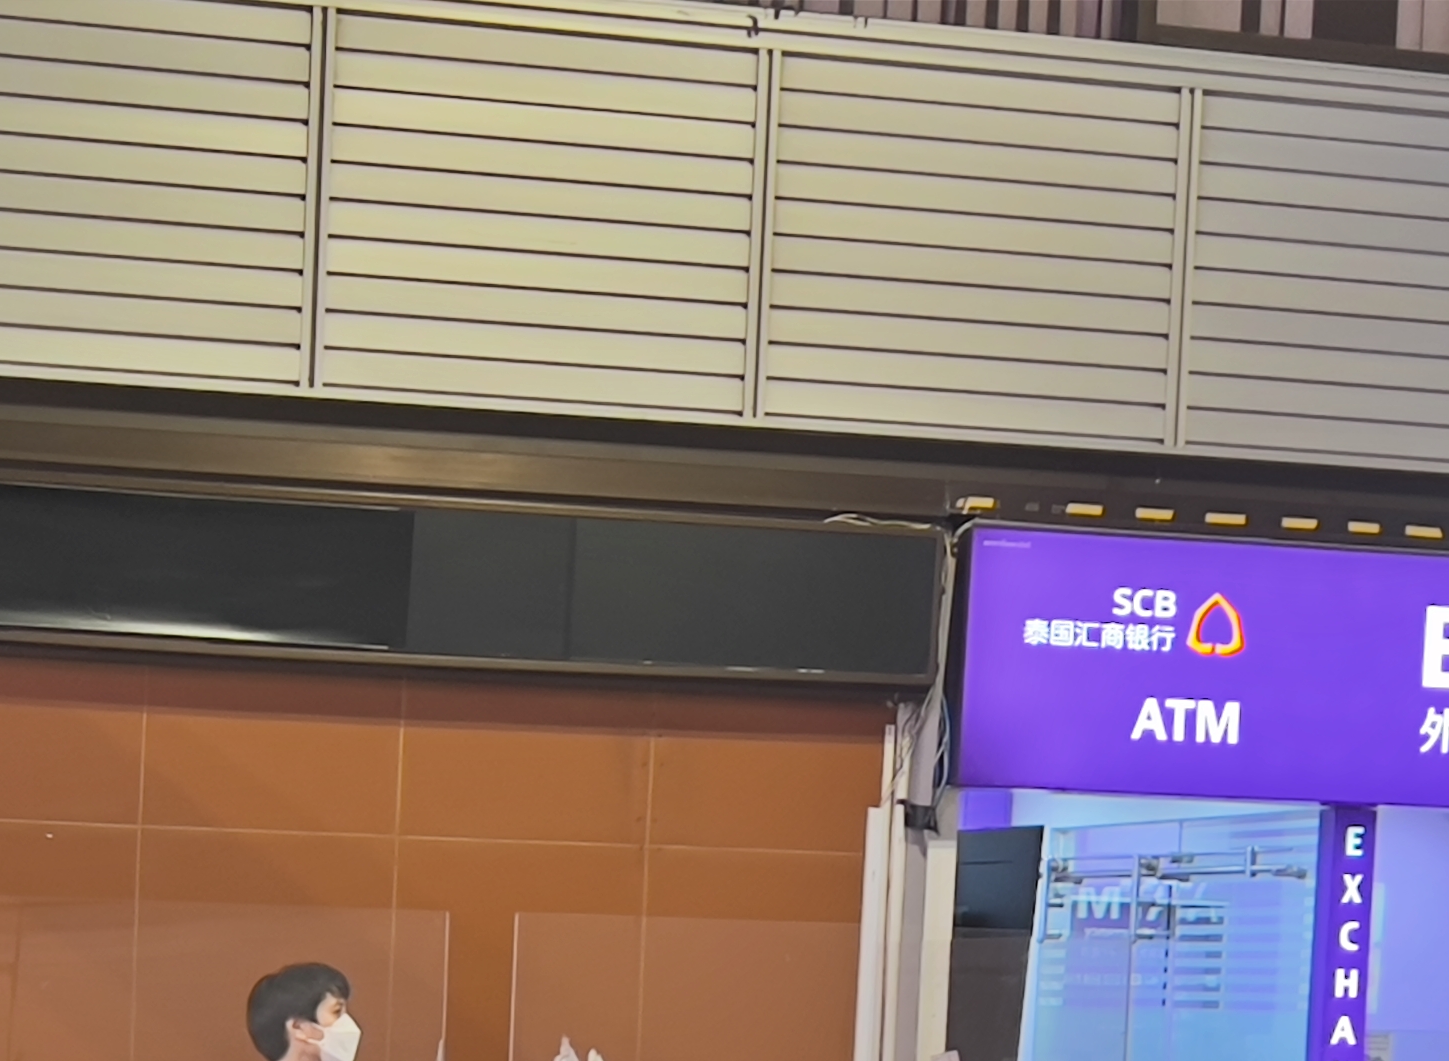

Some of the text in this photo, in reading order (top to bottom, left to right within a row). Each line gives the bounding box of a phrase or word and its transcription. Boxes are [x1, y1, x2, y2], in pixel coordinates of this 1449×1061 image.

[1111, 586, 1177, 619] SCB
[1023, 618, 1177, 652] 泰国汇商银行
[1130, 696, 1242, 746] ATM
